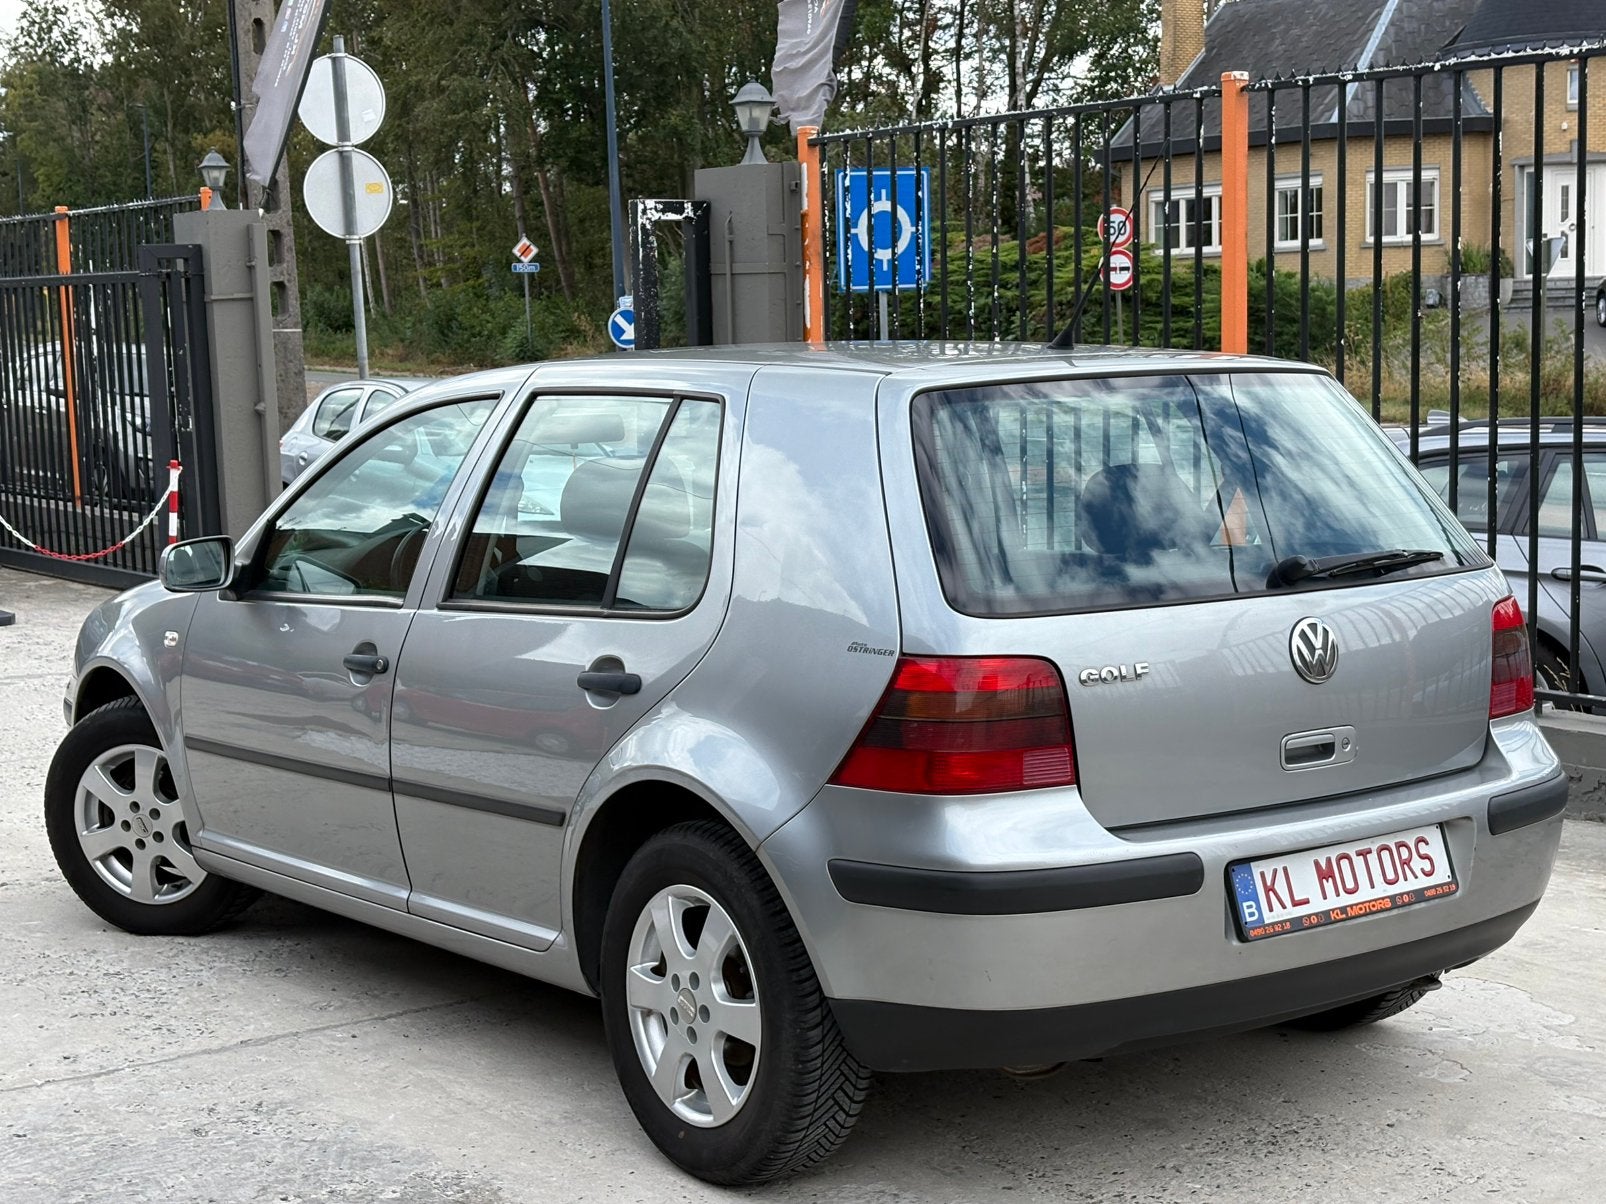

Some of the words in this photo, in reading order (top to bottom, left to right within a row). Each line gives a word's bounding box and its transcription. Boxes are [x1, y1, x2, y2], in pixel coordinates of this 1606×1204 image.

[1078, 662, 1150, 687] GOLF
[1259, 866, 1310, 913] KL
[1313, 836, 1436, 900] MOTORS
[1242, 901, 1259, 922] B
[1330, 908, 1346, 921] KL
[1347, 898, 1392, 917] MOTORS
